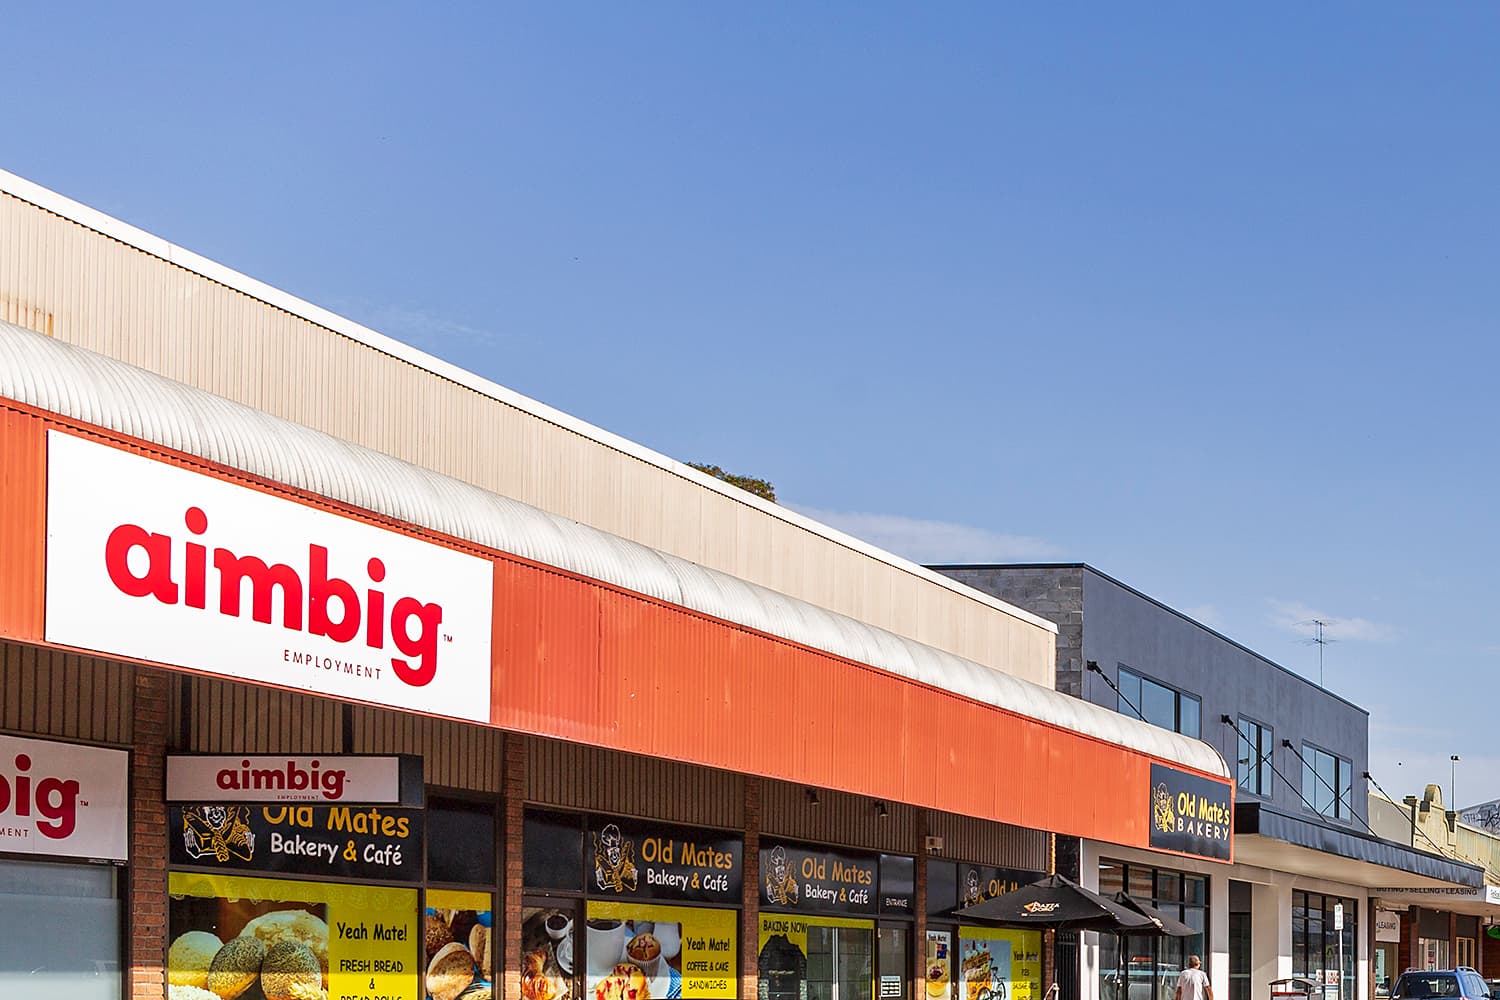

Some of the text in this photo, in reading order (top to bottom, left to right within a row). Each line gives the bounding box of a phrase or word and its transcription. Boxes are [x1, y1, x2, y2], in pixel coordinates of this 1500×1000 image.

[106, 506, 442, 687] aimbig
[283, 649, 382, 680] EMPLOYMENT
[216, 759, 346, 800] aimbig
[1177, 792, 1230, 826] Old Mate's
[327, 808, 410, 838] Mates
[1177, 817, 1229, 841] BAKERY
[271, 832, 403, 866] Bakery & Café
[642, 837, 733, 869] Old Mates
[647, 868, 729, 892] Bakery & Café
[802, 857, 872, 885] Old Mates
[805, 884, 869, 904] Bakery & Café
[1445, 888, 1478, 896] LEASING
[337, 922, 407, 941] Yeah Mate!
[763, 920, 808, 933] BAKING NOW
[686, 936, 730, 952] Yeah Mate!
[340, 960, 404, 973] FRESH BREAD
[686, 961, 708, 972] COFFEE
[369, 977, 375, 990] &
